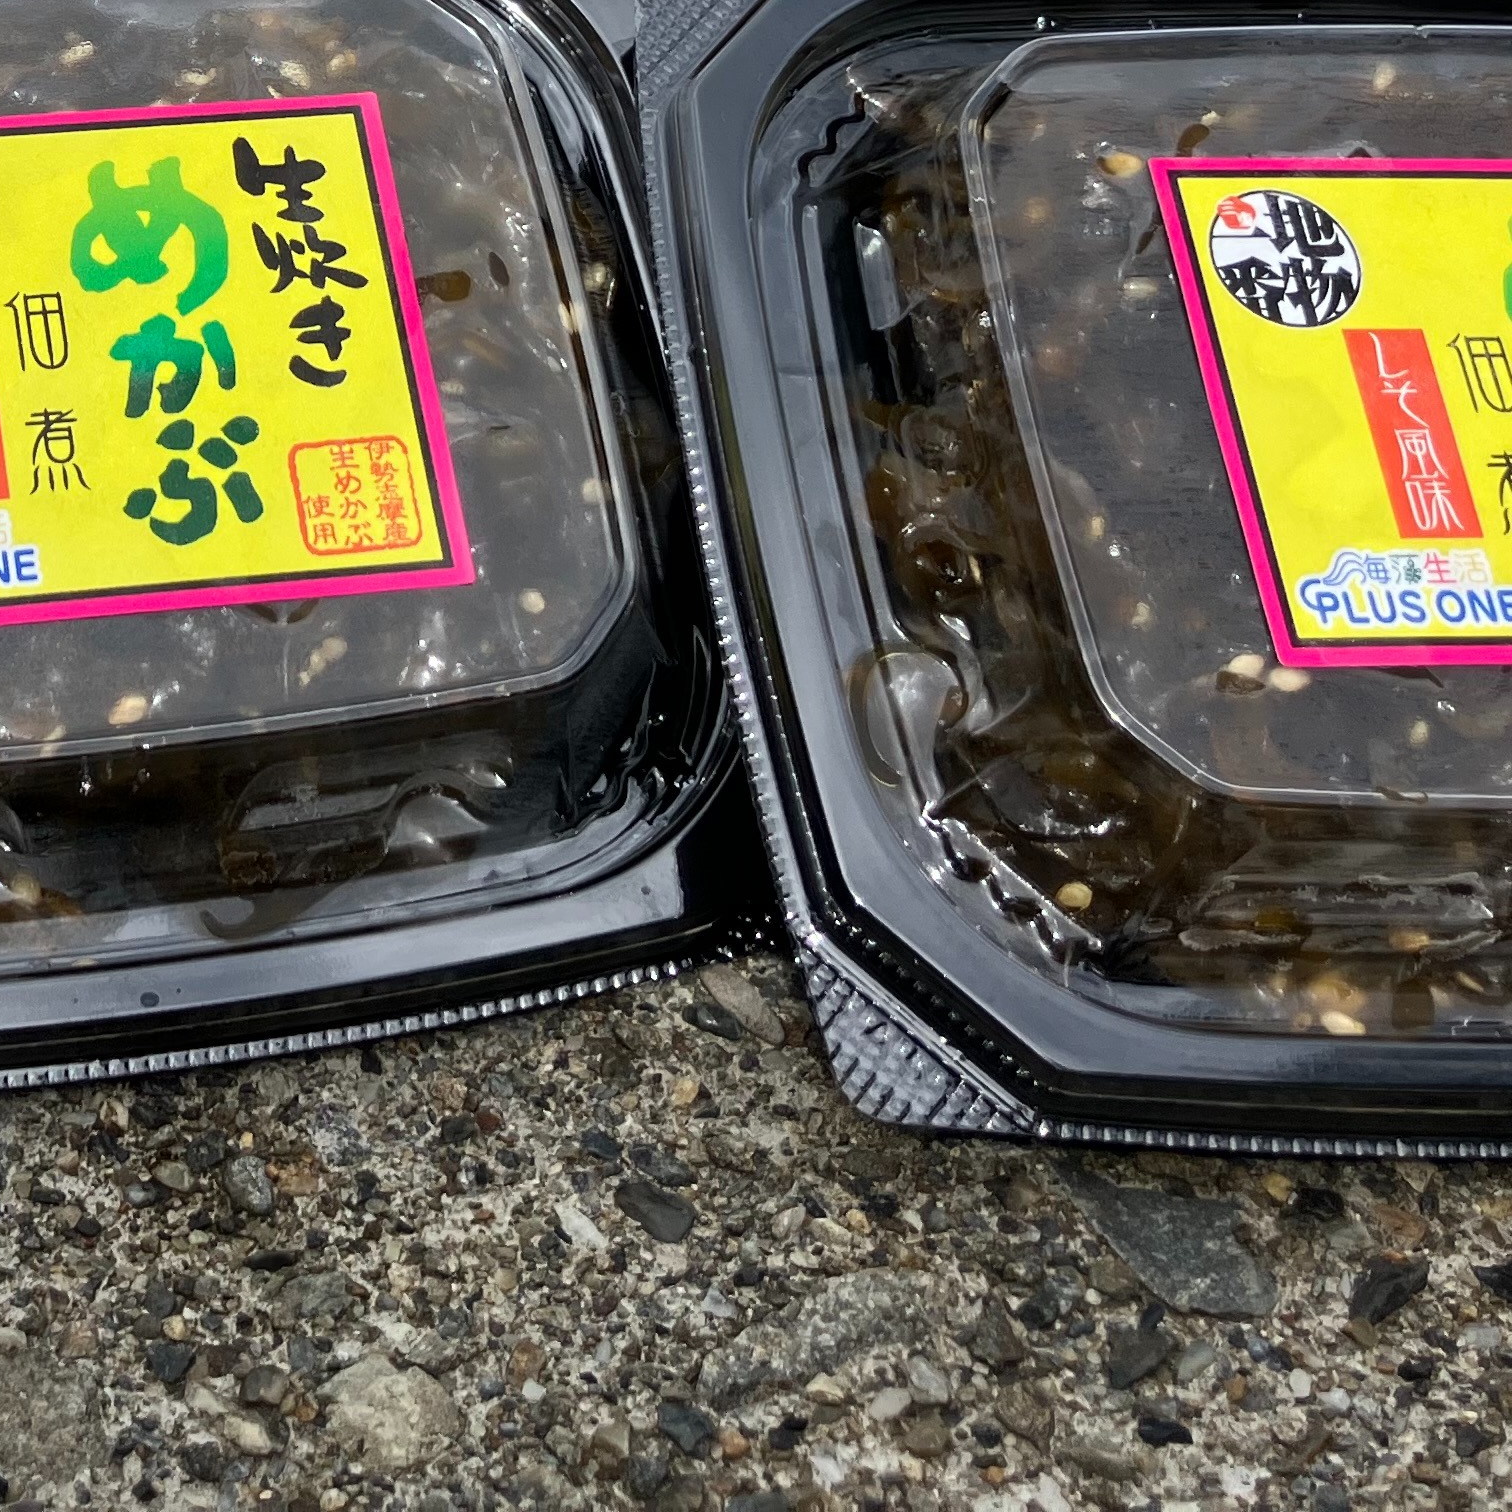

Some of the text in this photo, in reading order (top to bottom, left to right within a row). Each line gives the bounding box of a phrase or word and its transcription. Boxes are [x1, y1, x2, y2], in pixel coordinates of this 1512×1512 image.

[70, 156, 261, 546] めかぶ
[234, 137, 369, 387] 生炊き
[4, 291, 88, 496] 佃煮
[1368, 331, 1465, 531] しそ風味
[302, 494, 338, 545] 使用
[1300, 579, 1426, 623] PLUS
